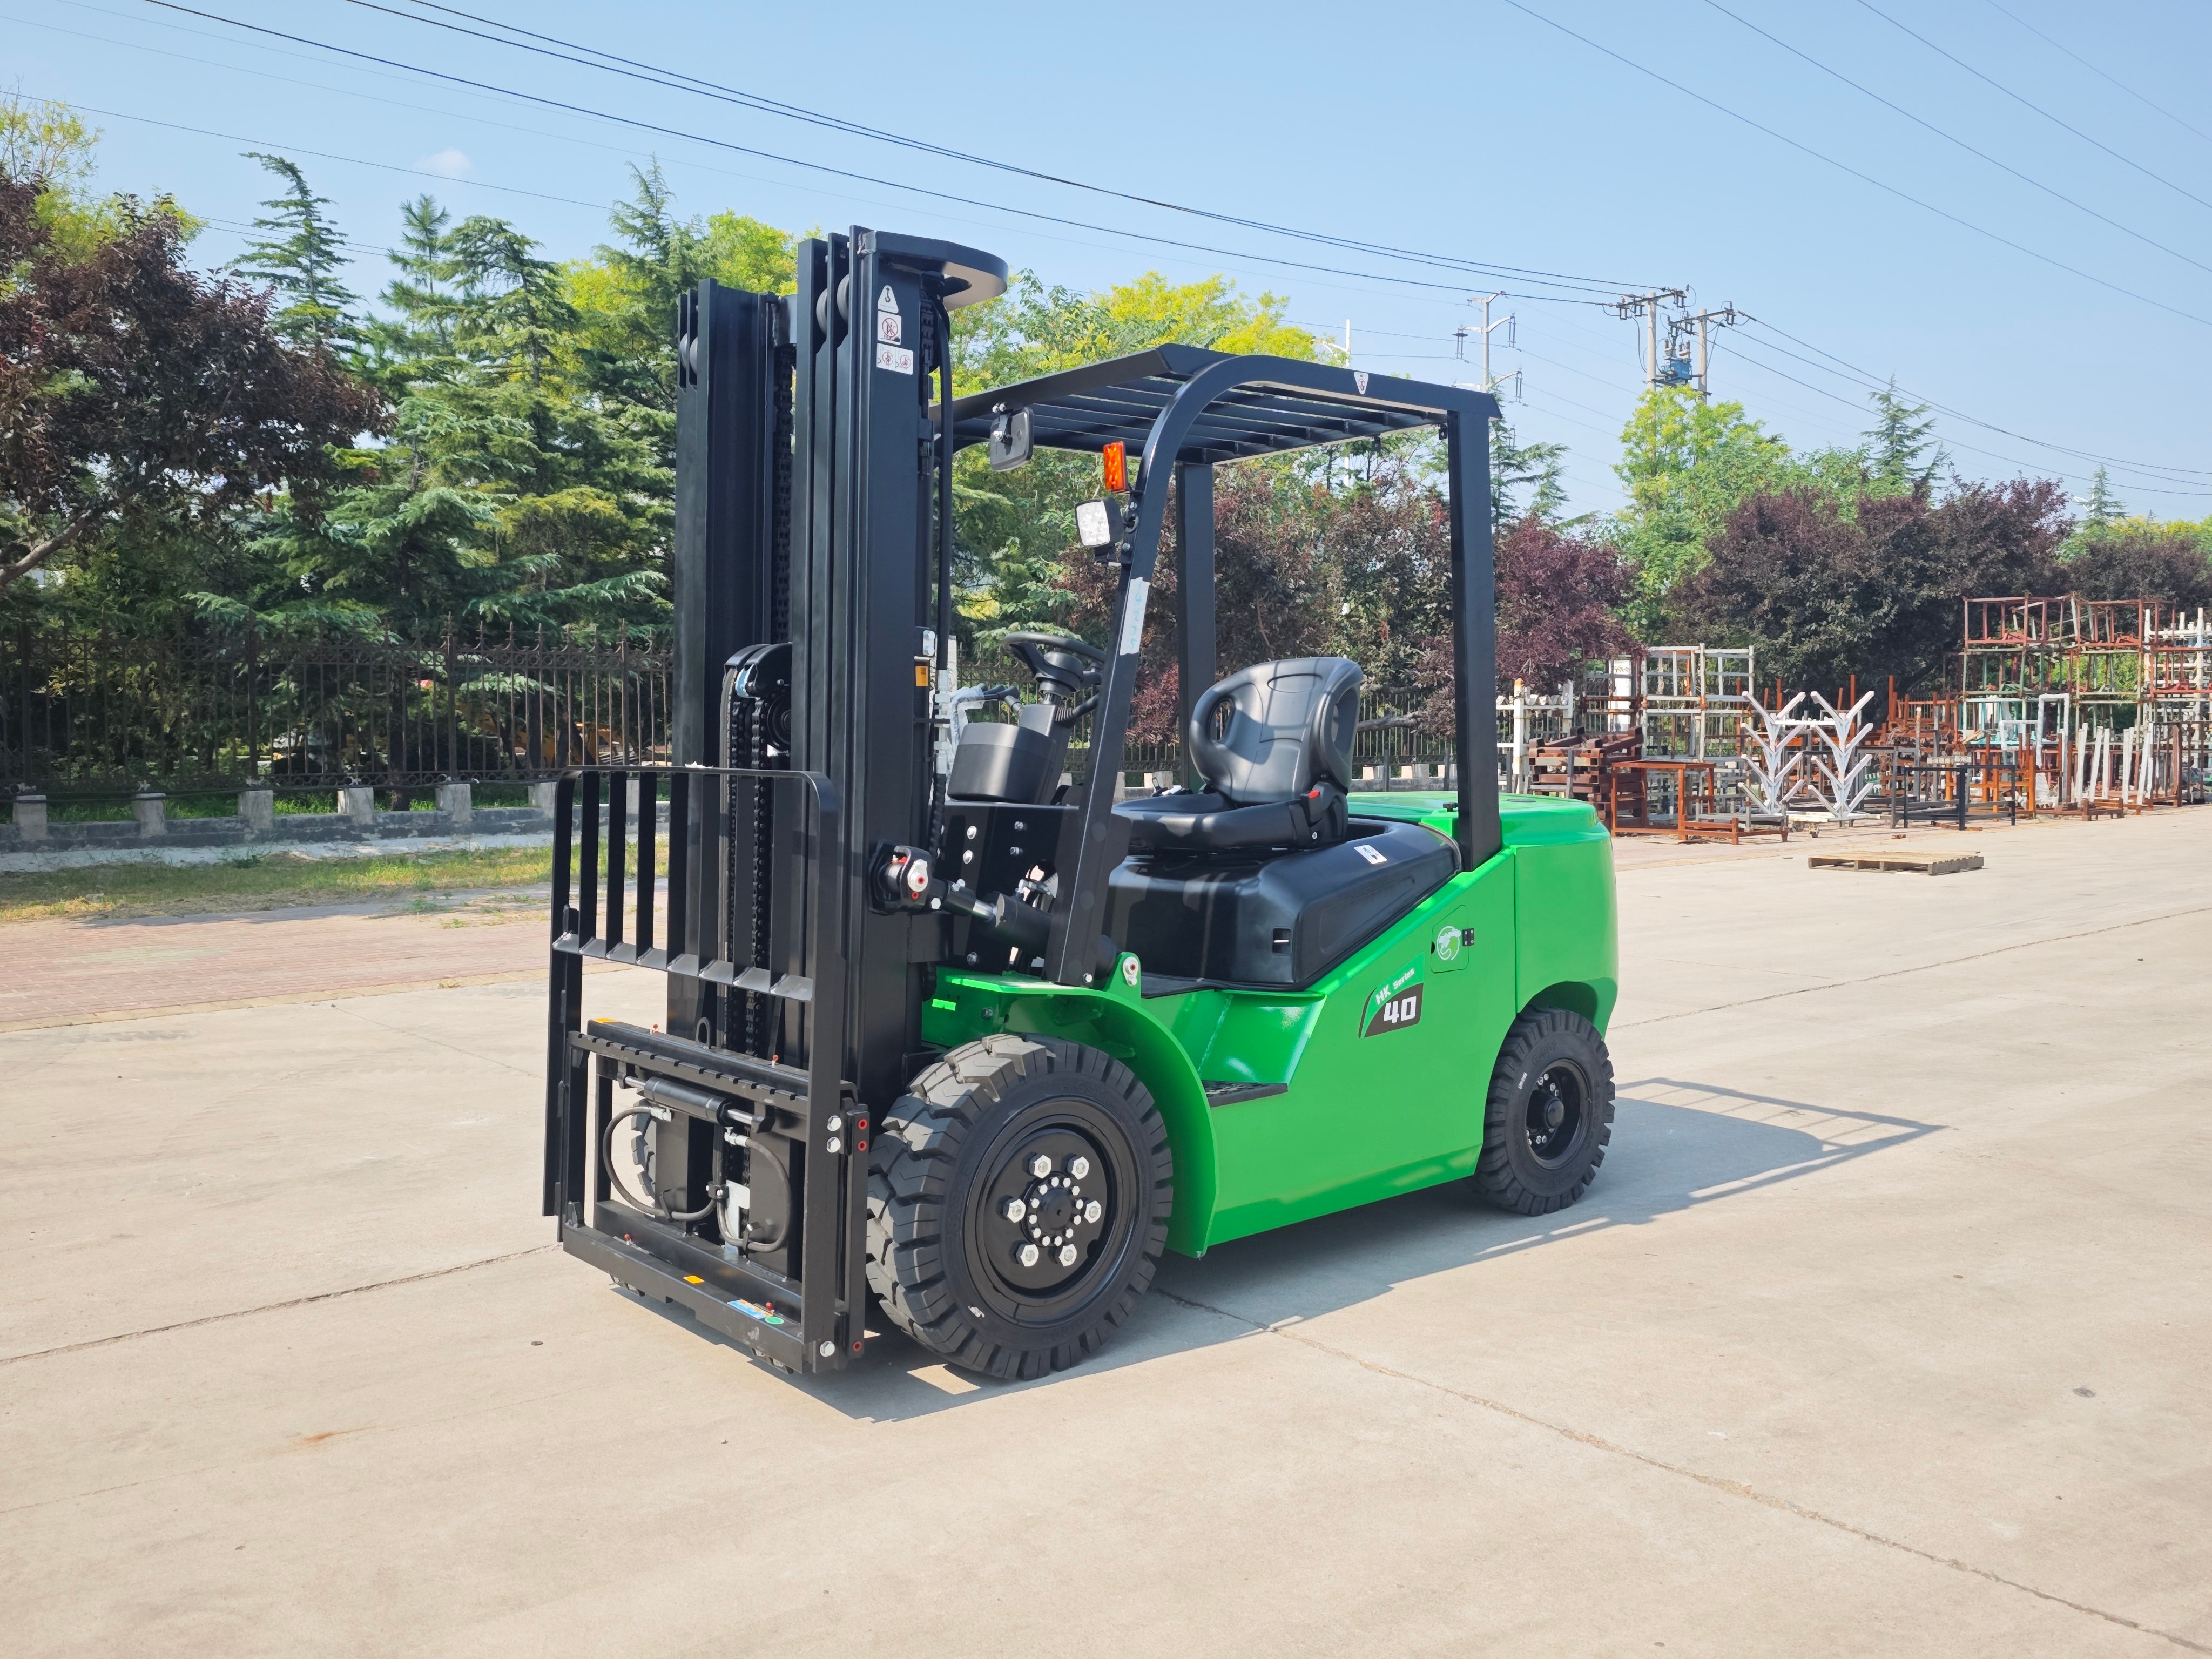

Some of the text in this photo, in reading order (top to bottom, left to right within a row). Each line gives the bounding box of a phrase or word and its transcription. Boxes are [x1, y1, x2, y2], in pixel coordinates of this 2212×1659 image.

[1375, 968, 1414, 1005] HK Series
[1384, 996, 1417, 1023] 40
